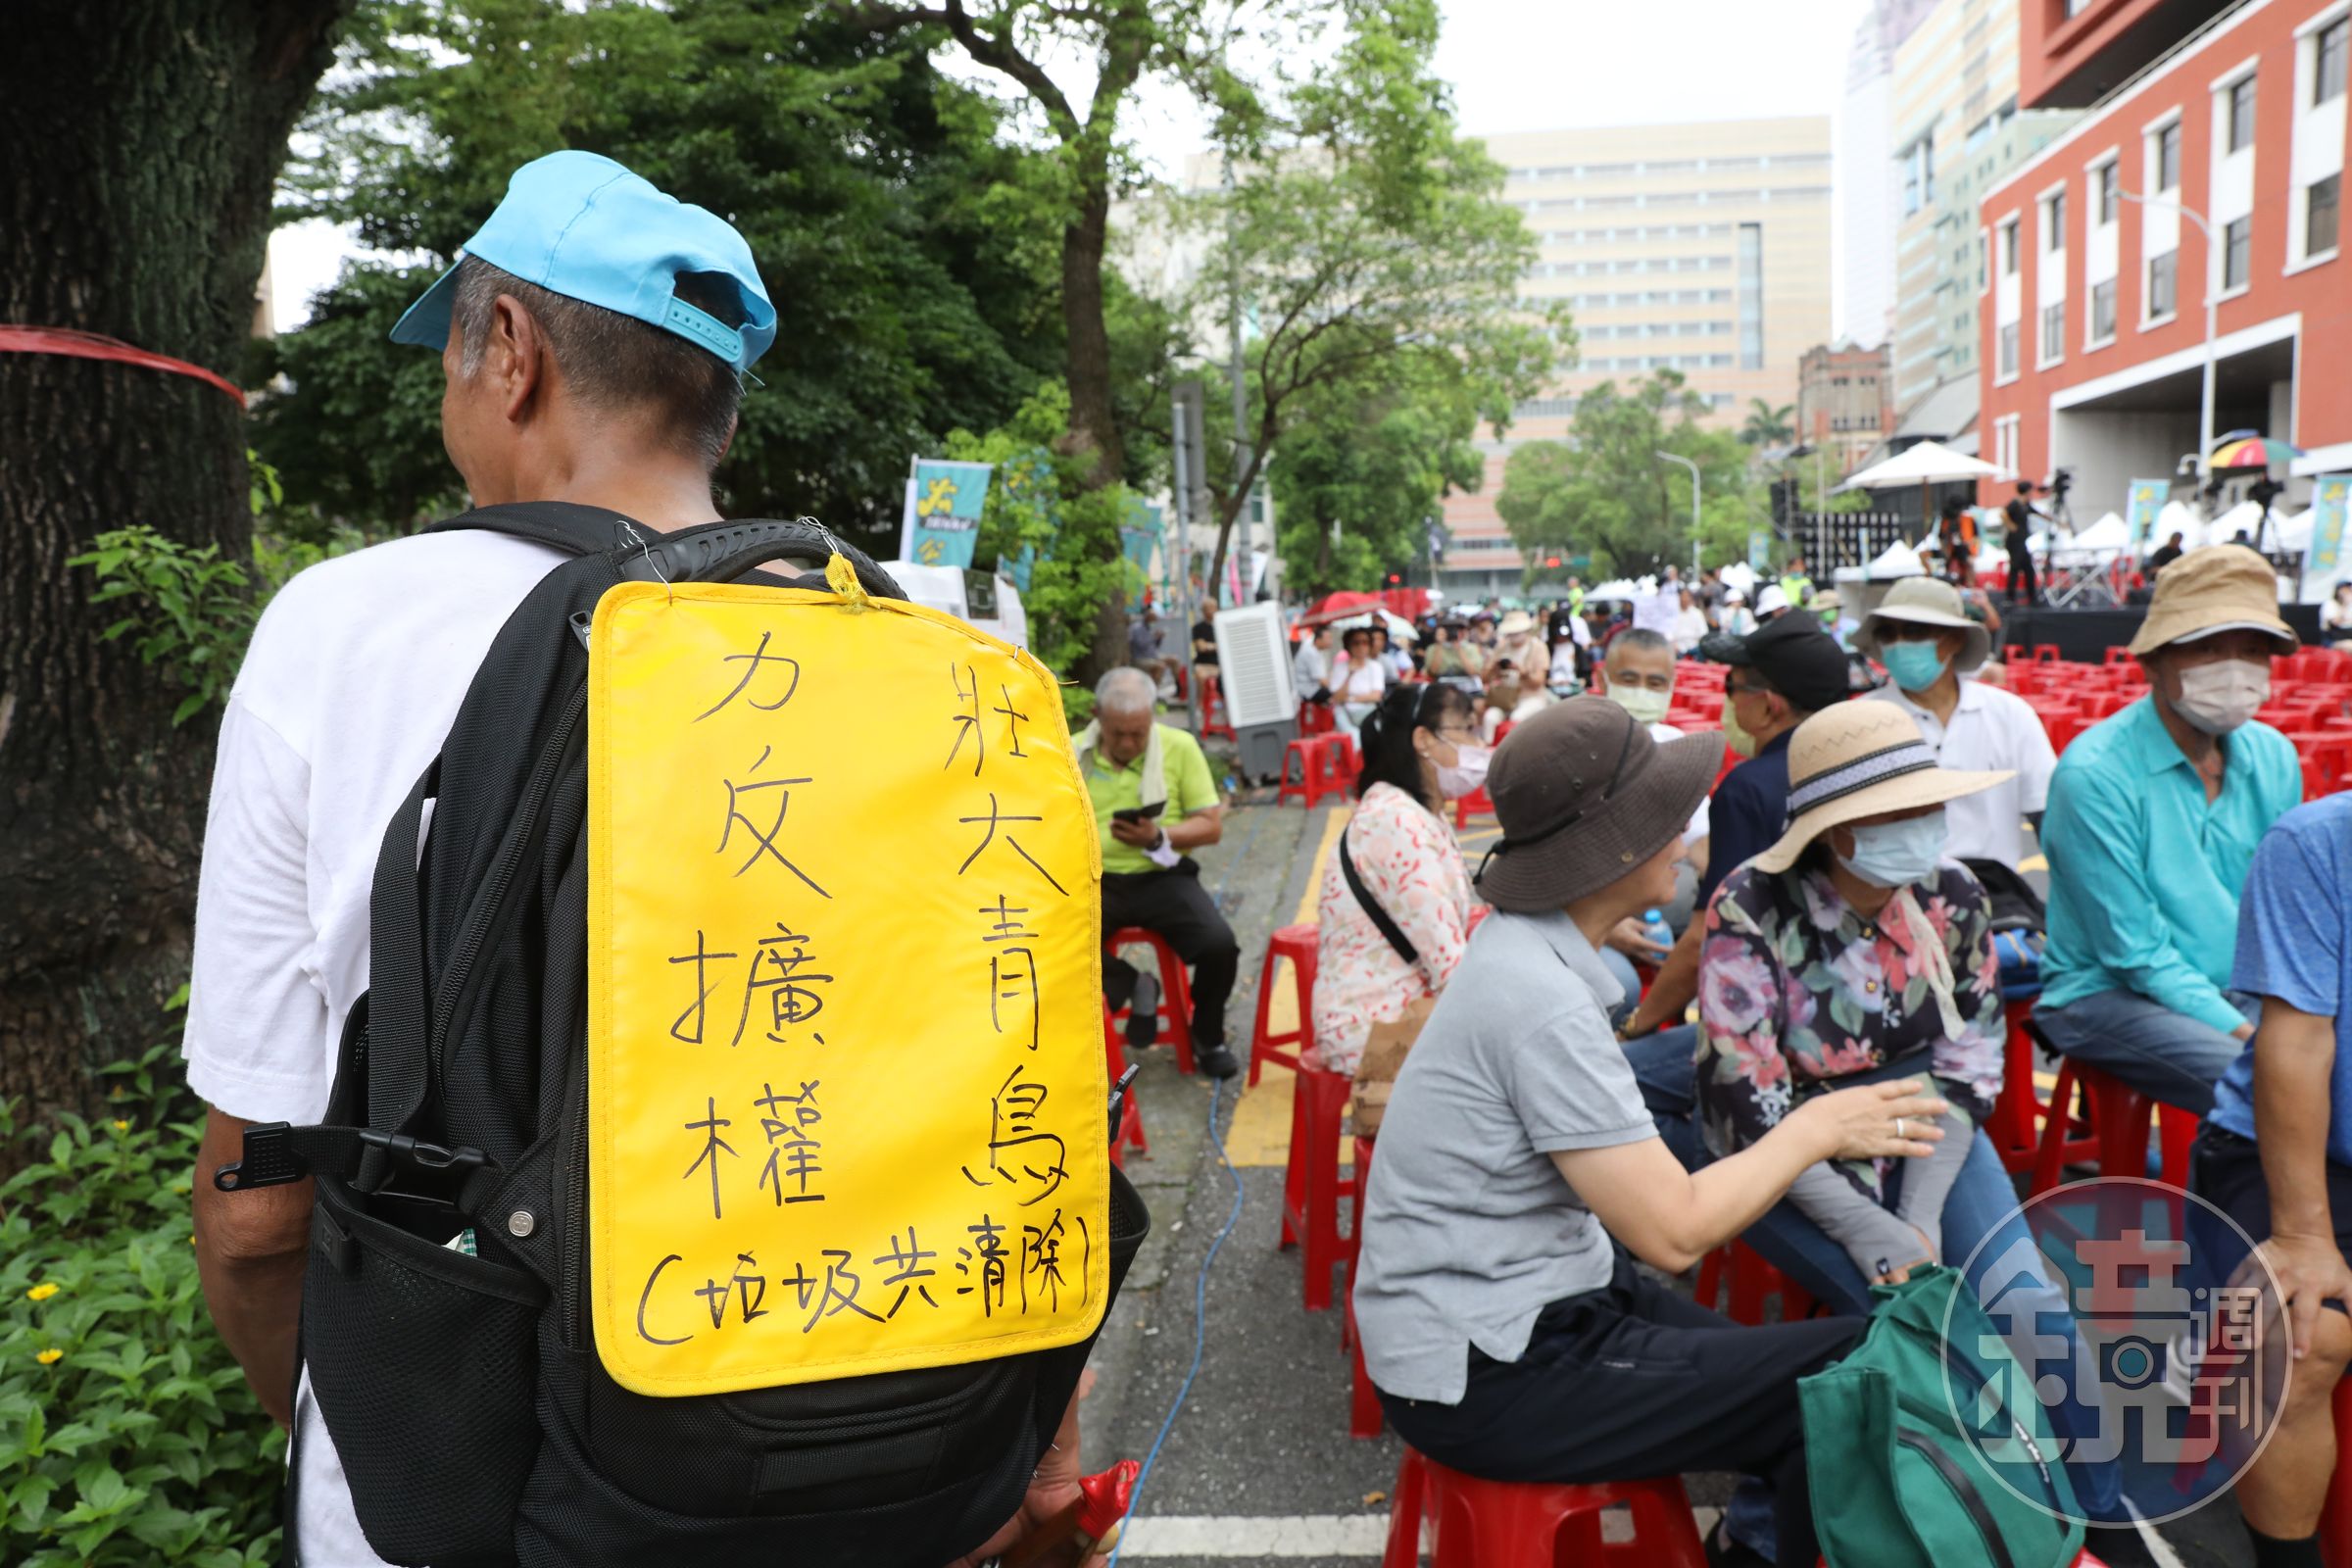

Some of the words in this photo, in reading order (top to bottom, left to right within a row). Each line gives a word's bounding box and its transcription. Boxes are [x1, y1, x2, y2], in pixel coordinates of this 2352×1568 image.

[669, 631, 833, 1219] 力反擴權
[945, 660, 1070, 1206] 壯大青鳥
